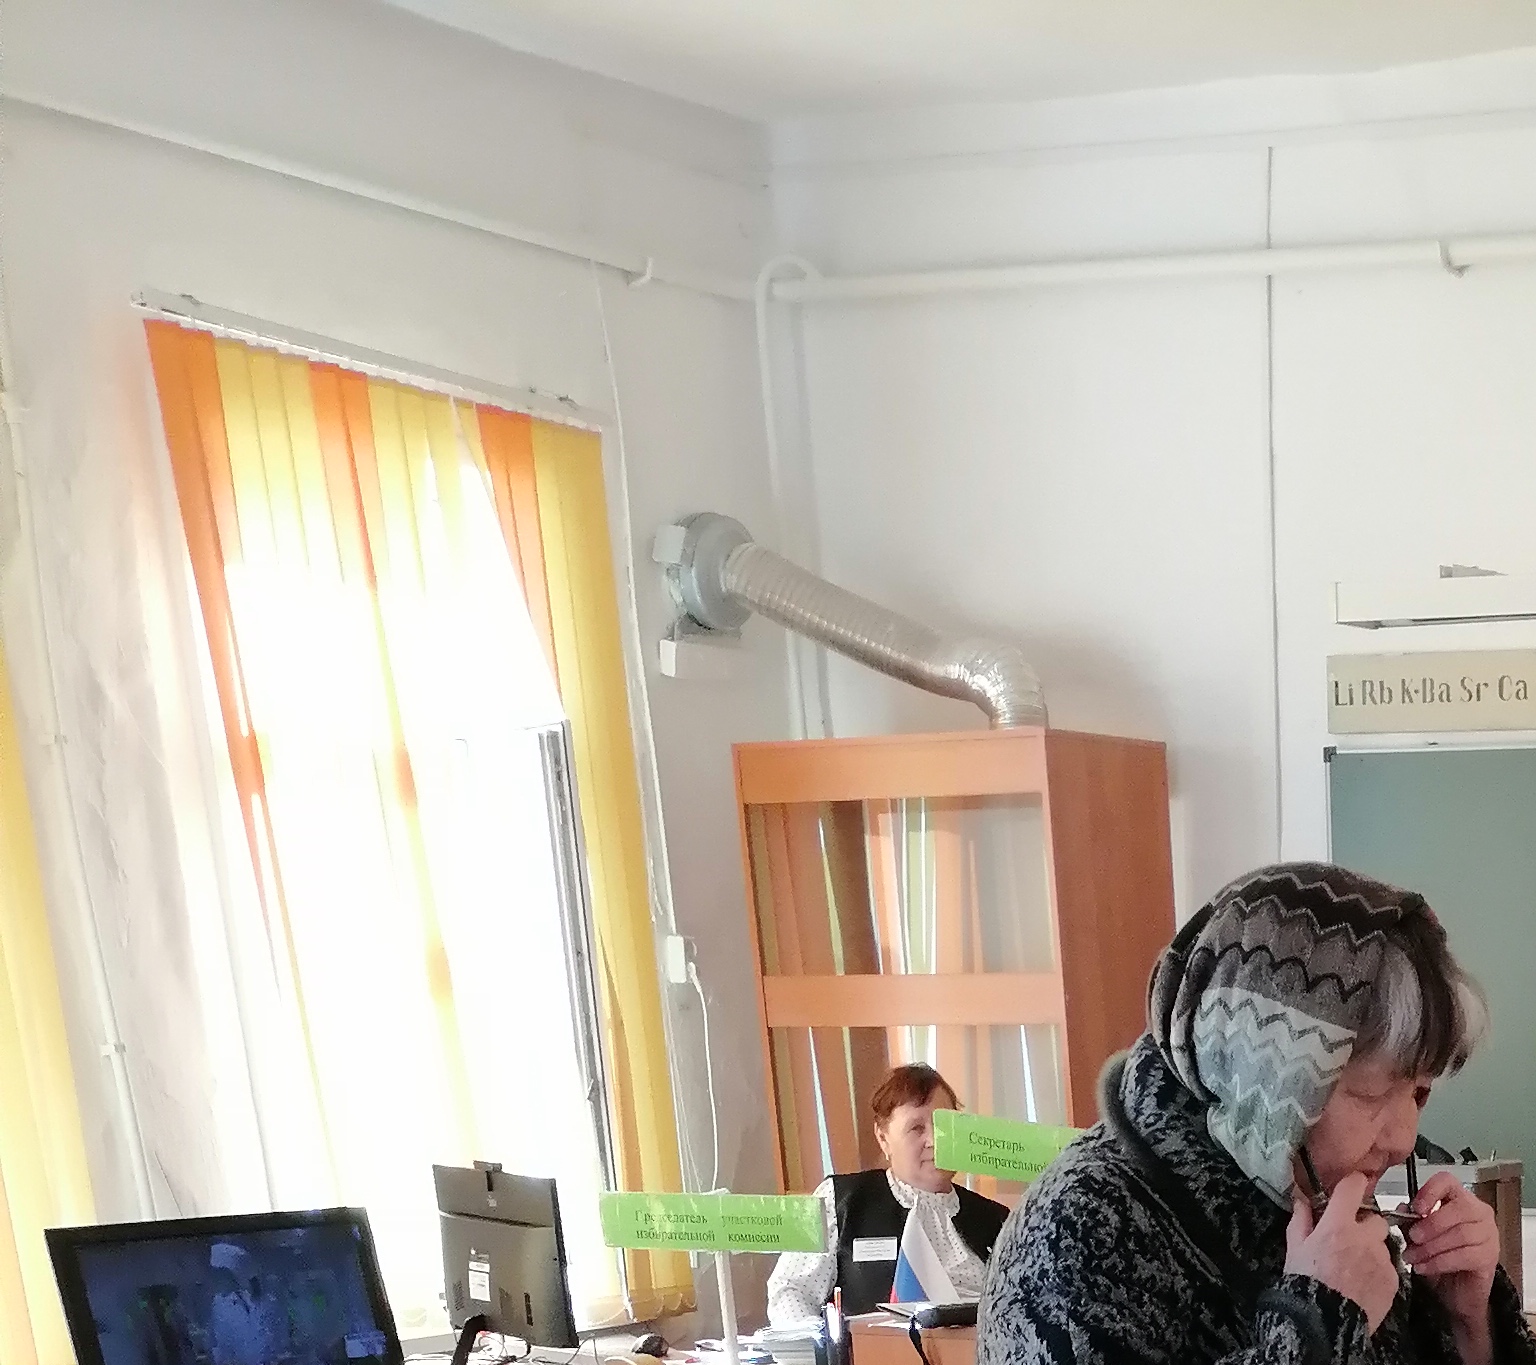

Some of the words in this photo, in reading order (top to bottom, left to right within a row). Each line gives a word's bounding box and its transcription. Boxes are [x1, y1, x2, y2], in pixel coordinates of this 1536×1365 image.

[1334, 680, 1353, 706] Li
[1362, 678, 1393, 704] Rb
[1460, 676, 1489, 702] Sr
[1498, 674, 1528, 701] Ca
[969, 1132, 1025, 1153] Секретарь
[728, 1231, 780, 1243] комиссии
